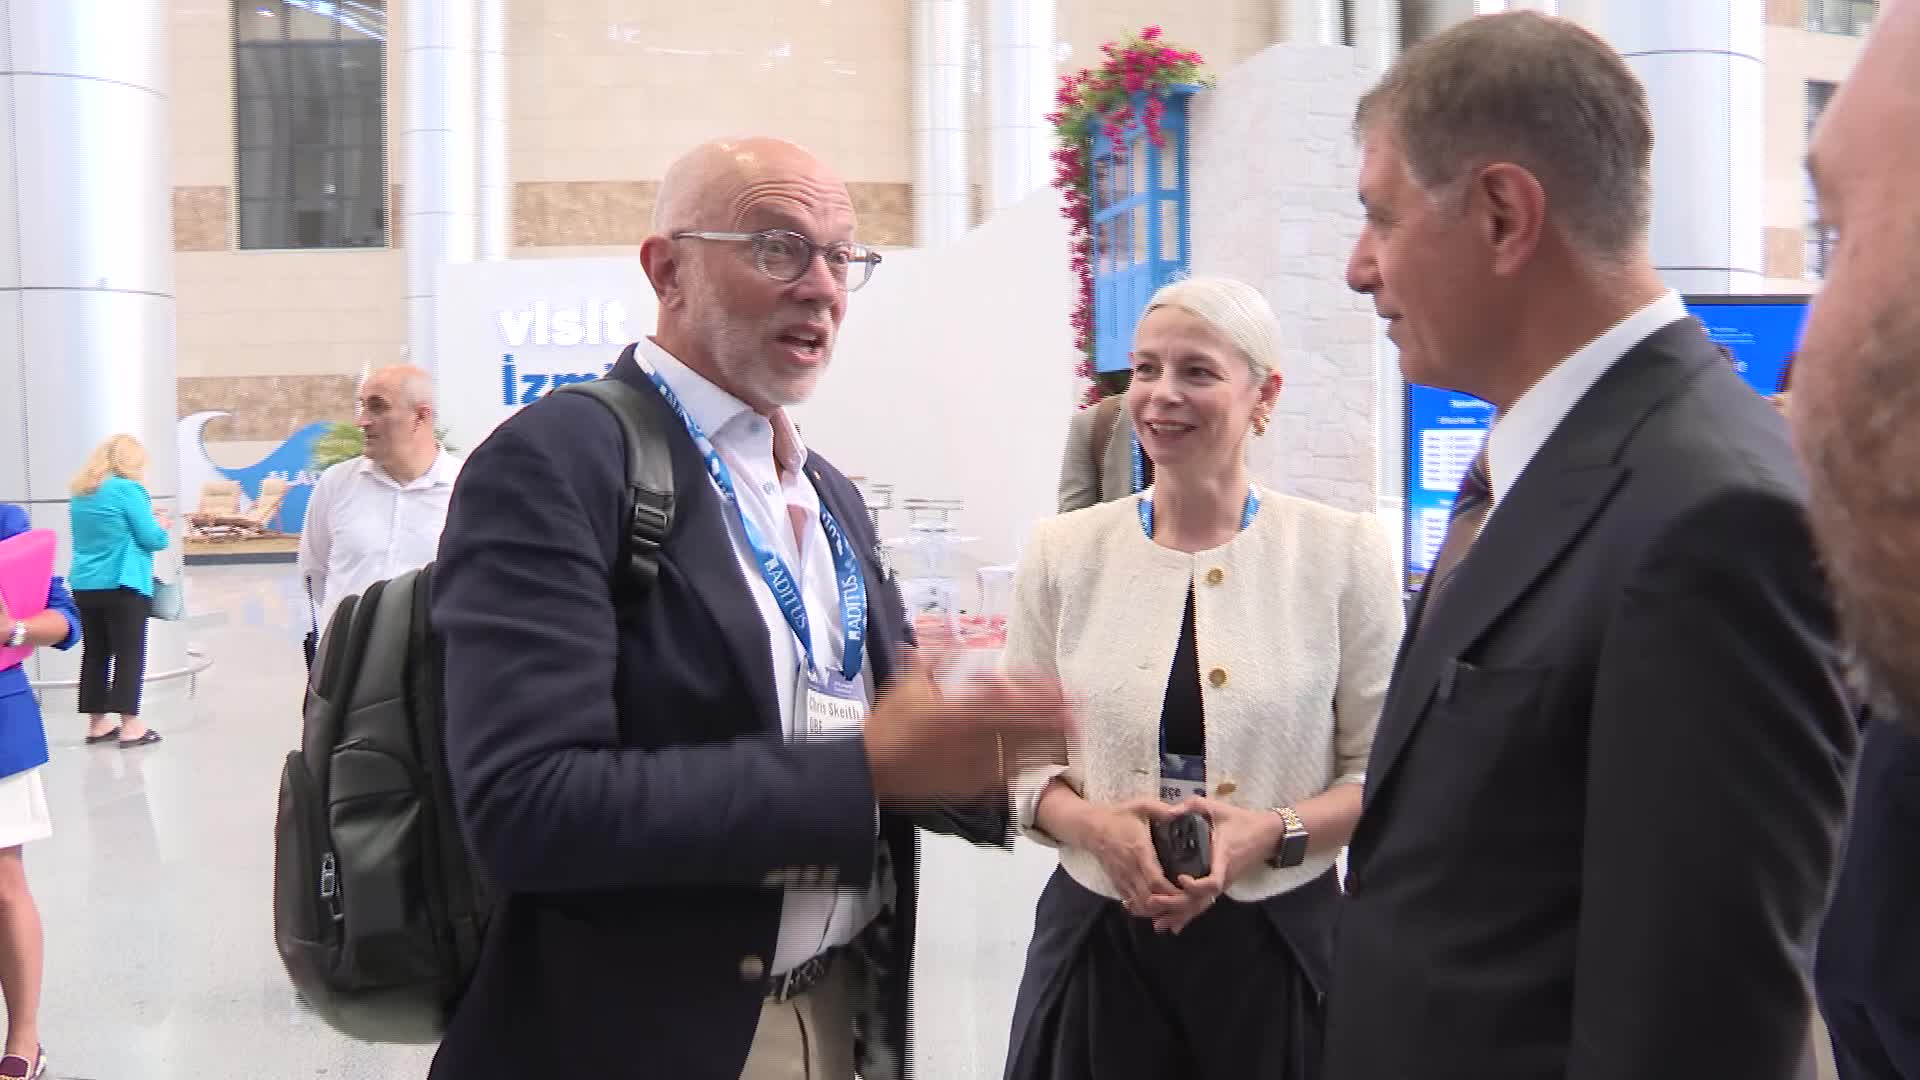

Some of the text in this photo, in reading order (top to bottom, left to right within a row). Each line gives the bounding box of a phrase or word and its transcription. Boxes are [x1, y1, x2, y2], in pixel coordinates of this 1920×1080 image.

[497, 300, 629, 347] visit
[808, 695, 860, 720] Chris Skeith
